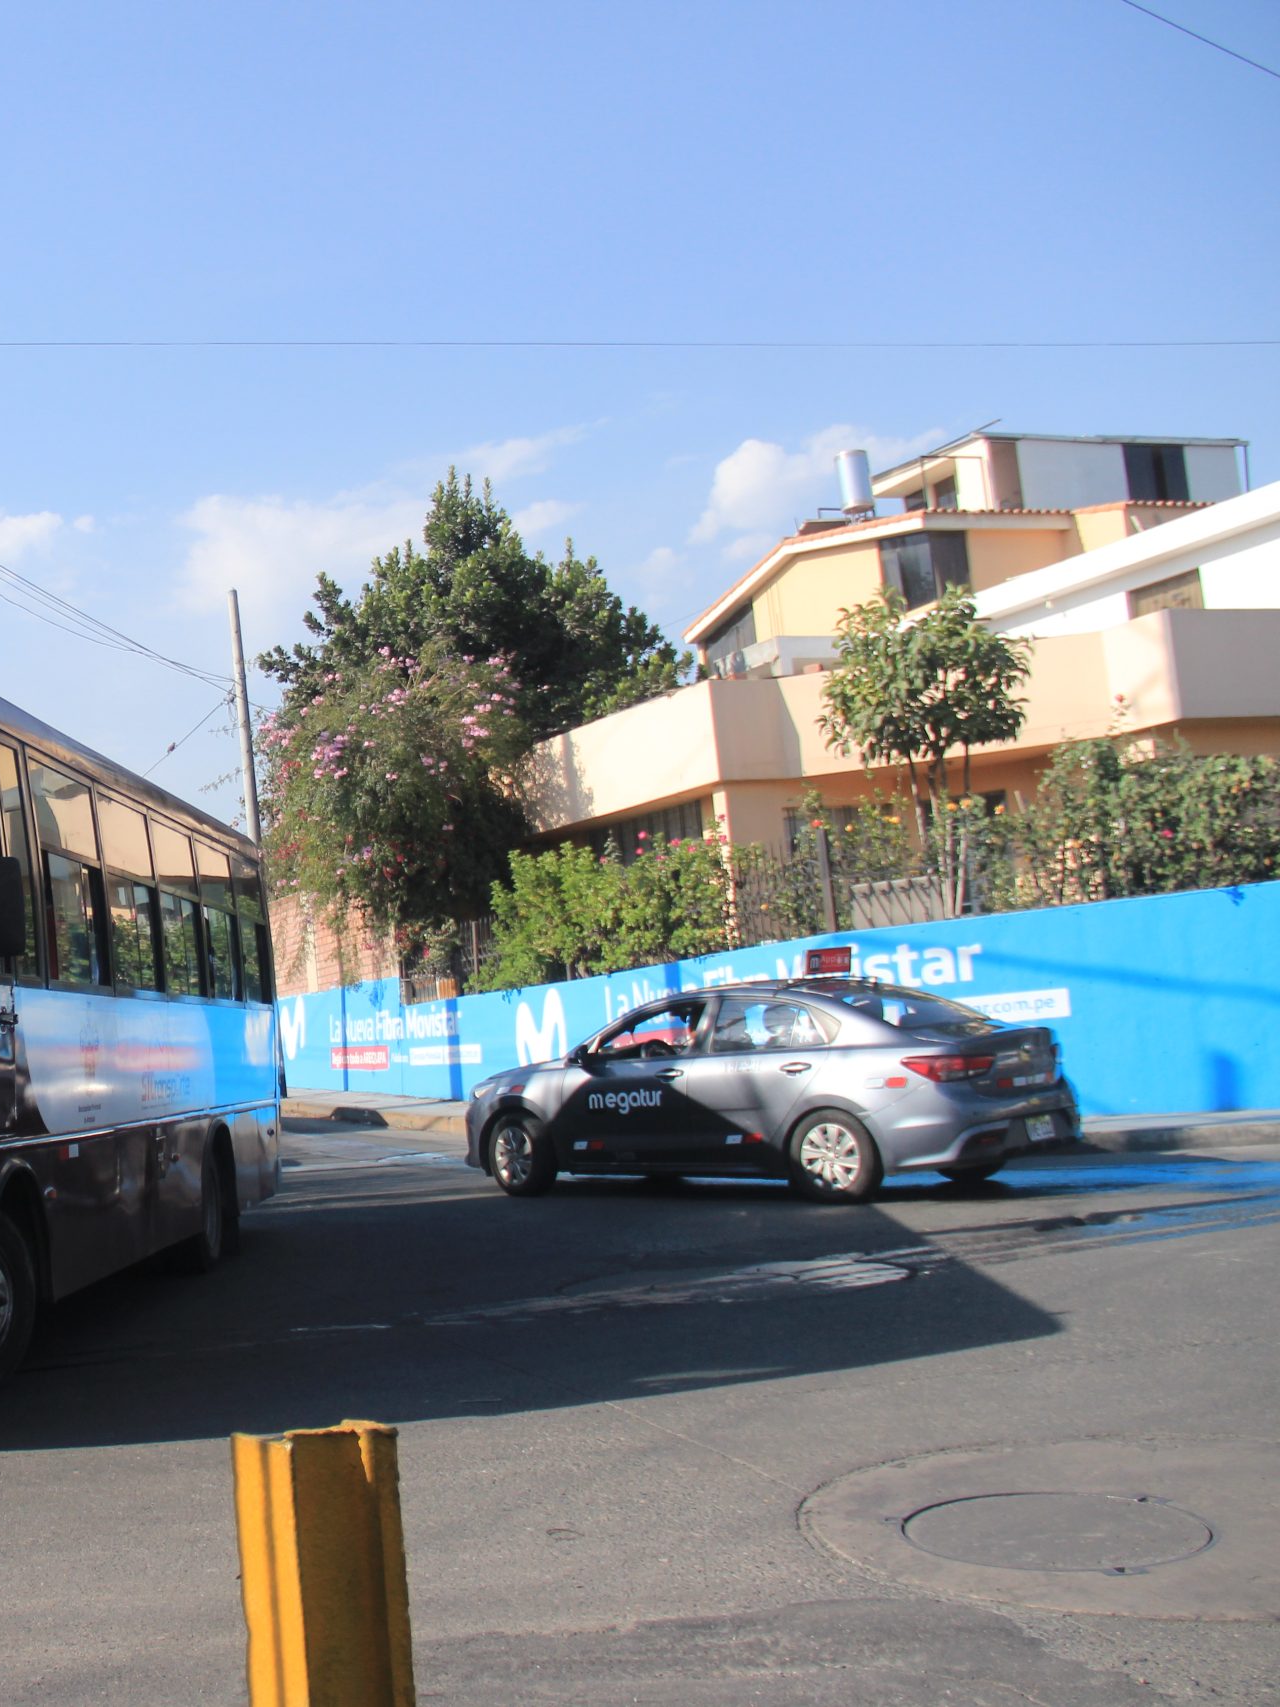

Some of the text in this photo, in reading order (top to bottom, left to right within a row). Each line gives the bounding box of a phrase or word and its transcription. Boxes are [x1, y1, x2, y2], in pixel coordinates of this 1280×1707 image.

[330, 1014, 342, 1042] La
[376, 1009, 404, 1041] Fibra
[404, 1005, 462, 1040] Movistar
[589, 1089, 662, 1114] megatur
